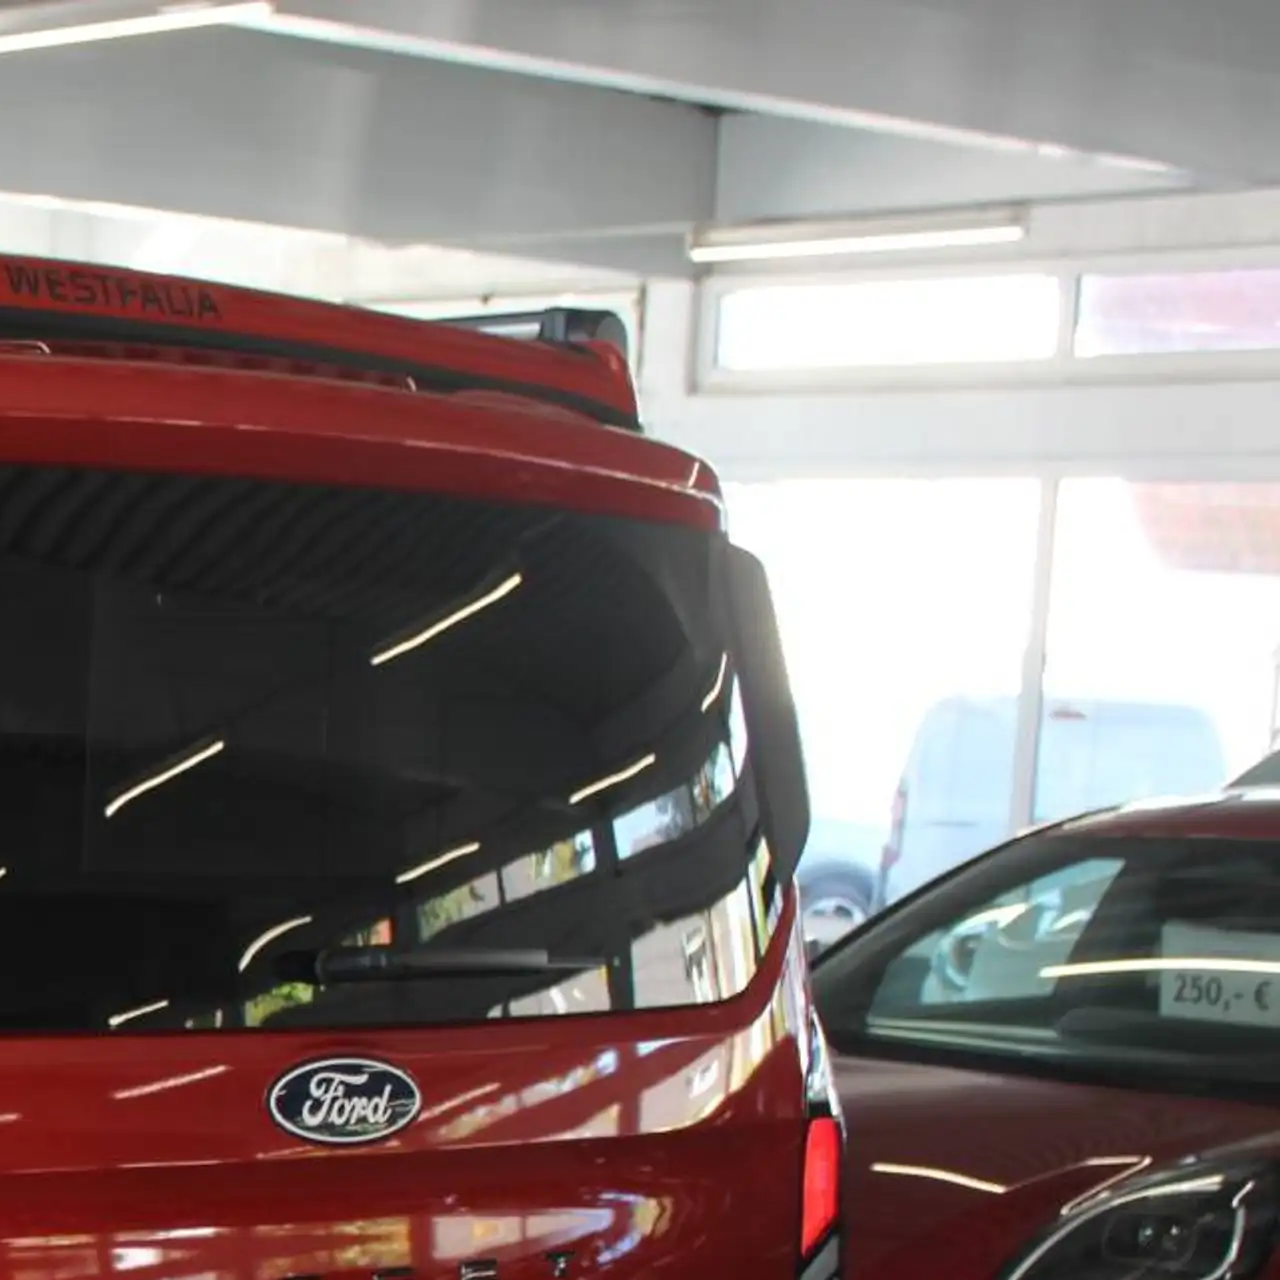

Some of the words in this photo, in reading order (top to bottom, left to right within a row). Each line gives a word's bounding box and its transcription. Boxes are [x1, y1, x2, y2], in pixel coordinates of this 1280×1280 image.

[4, 262, 223, 322] WESTFALIA
[1172, 972, 1245, 1012] 250,-
[302, 1072, 393, 1127] Ford
